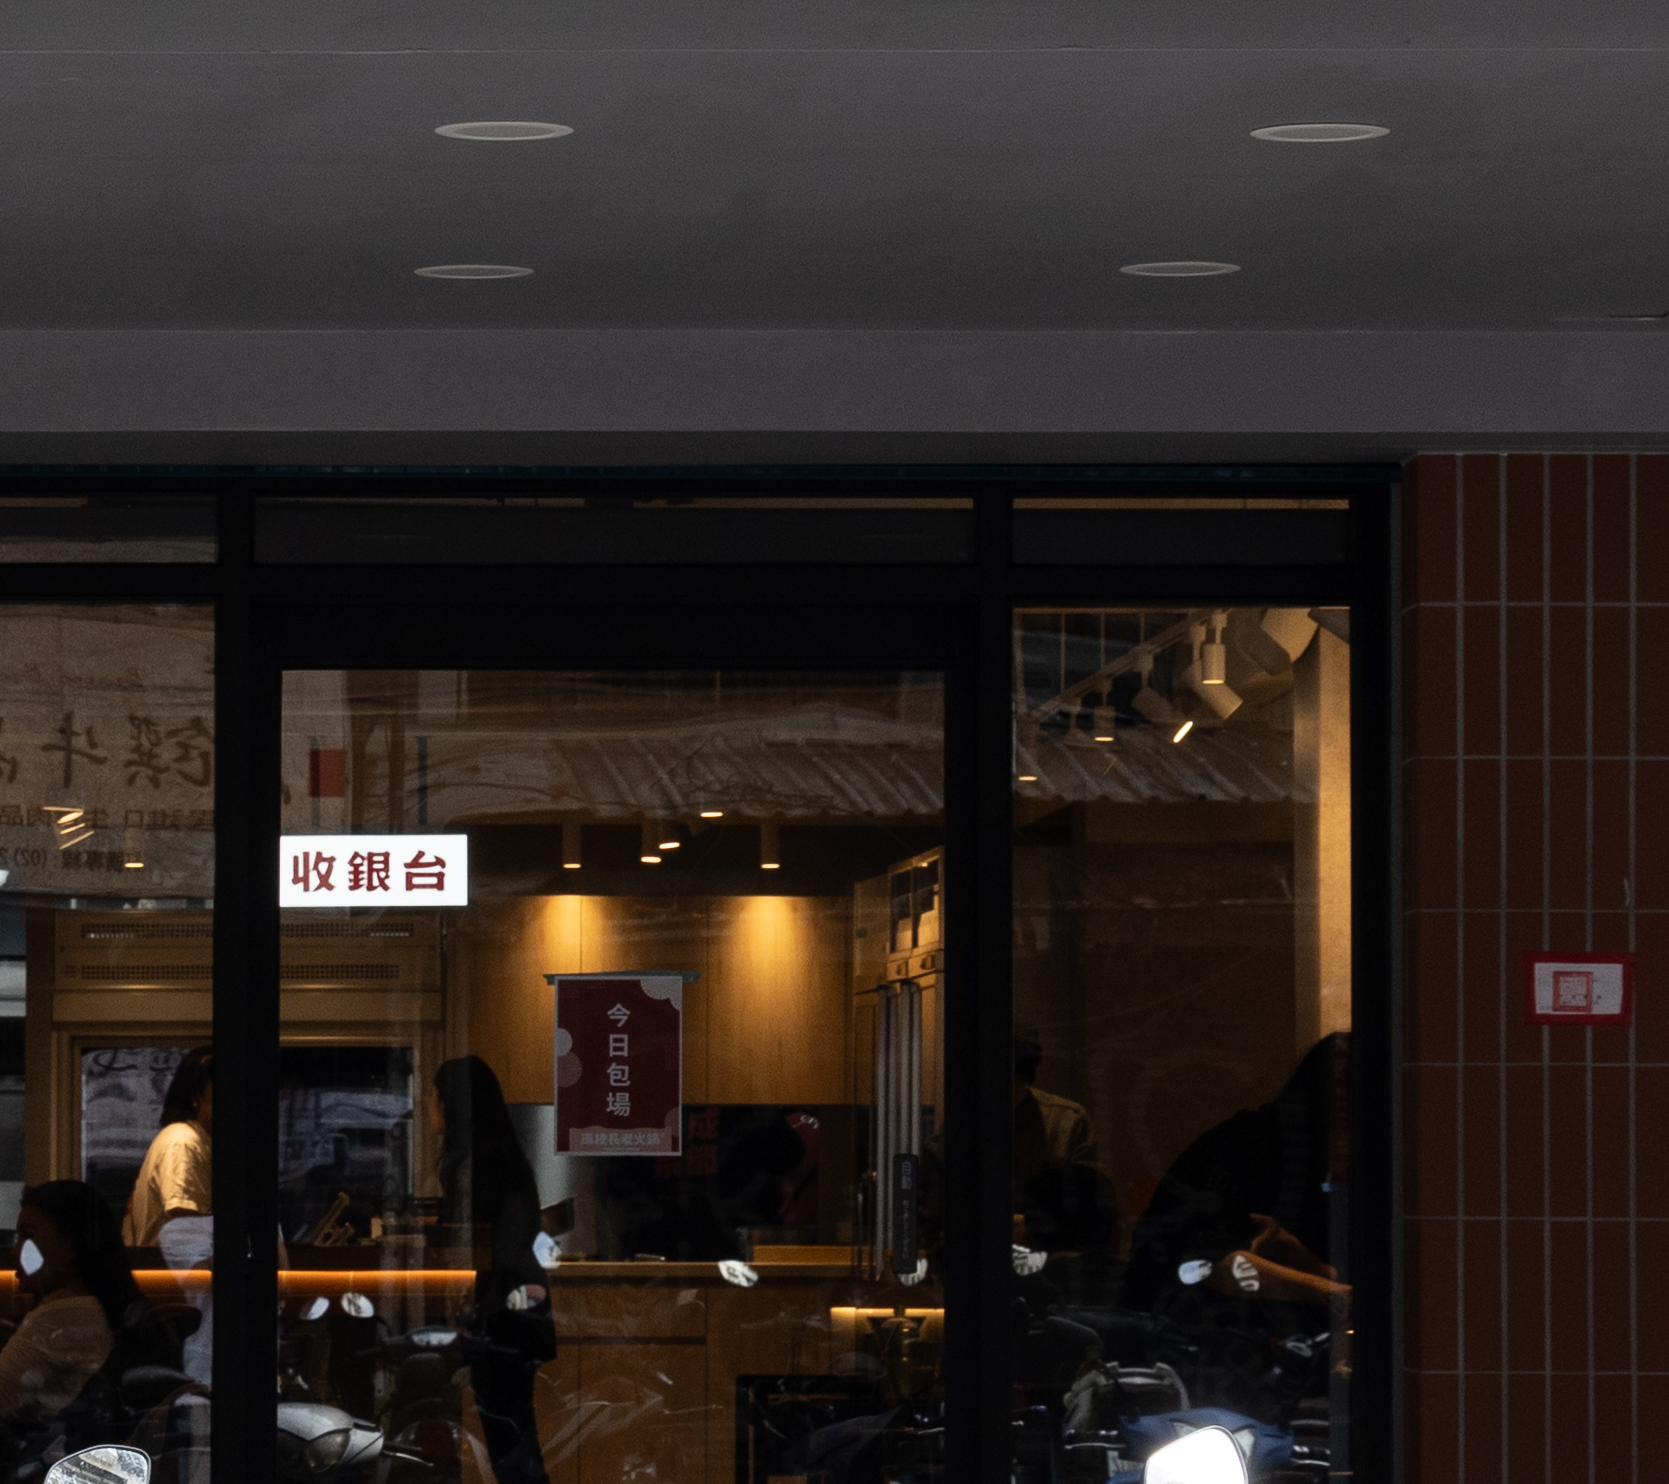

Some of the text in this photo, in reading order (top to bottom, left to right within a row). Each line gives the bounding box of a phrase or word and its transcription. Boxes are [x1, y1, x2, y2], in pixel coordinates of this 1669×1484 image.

[291, 850, 448, 894] 收銀台
[605, 1002, 632, 1118] 今日包場
